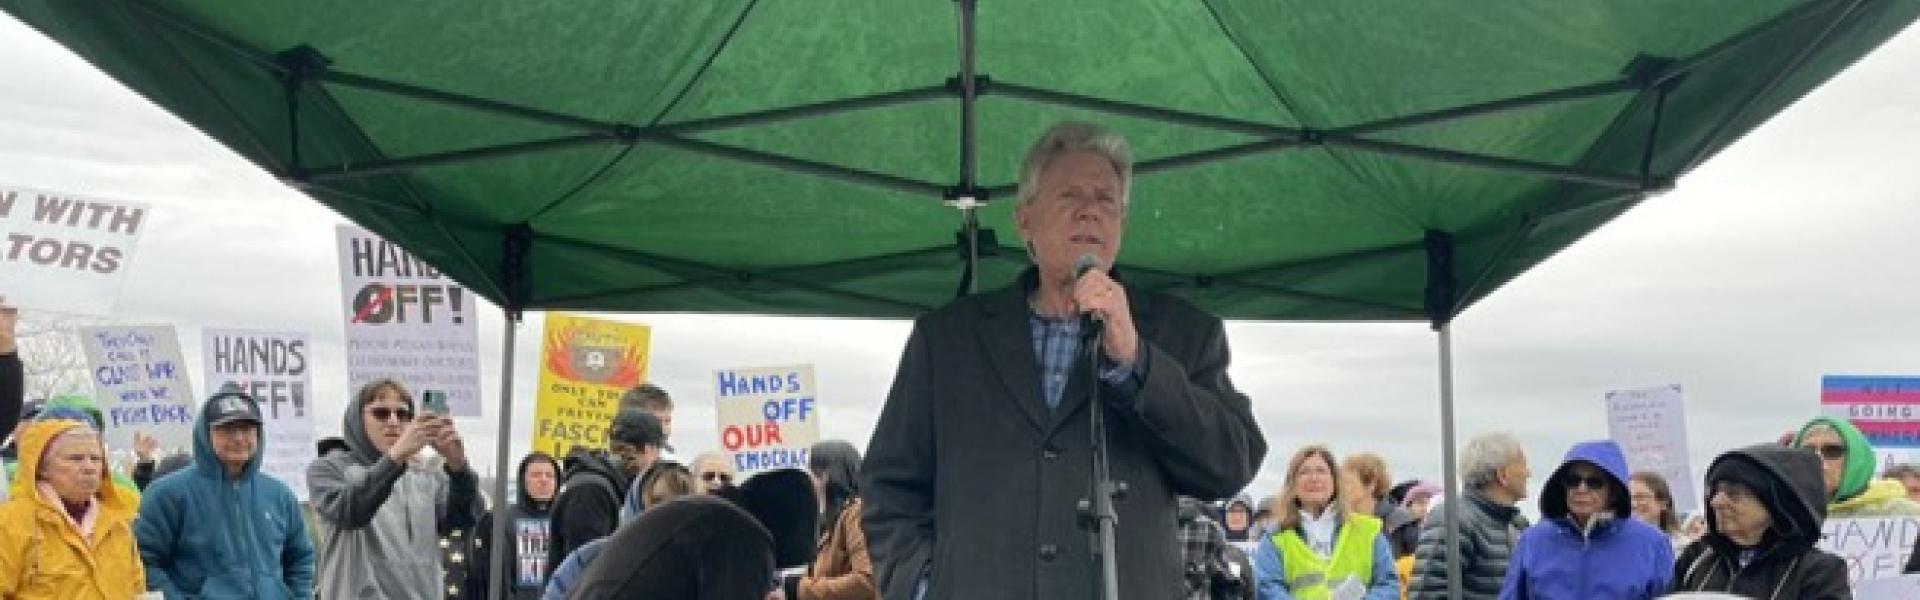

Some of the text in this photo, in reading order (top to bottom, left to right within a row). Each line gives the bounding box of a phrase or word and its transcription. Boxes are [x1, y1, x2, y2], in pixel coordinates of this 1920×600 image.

[34, 195, 143, 234] WITH
[0, 231, 123, 274] TORS
[352, 281, 464, 325] OFF!
[213, 336, 306, 375] HANDS
[552, 384, 585, 397] ONLY
[718, 371, 800, 396] HANDS
[242, 381, 304, 419] FF!
[557, 408, 612, 420] PREVEN
[577, 398, 607, 409] CAN
[764, 397, 815, 422] OFF
[1849, 405, 1912, 418] GOING
[723, 420, 782, 451] OUR
[735, 447, 809, 473] EMOCRAC
[1820, 518, 1918, 551] HAND
